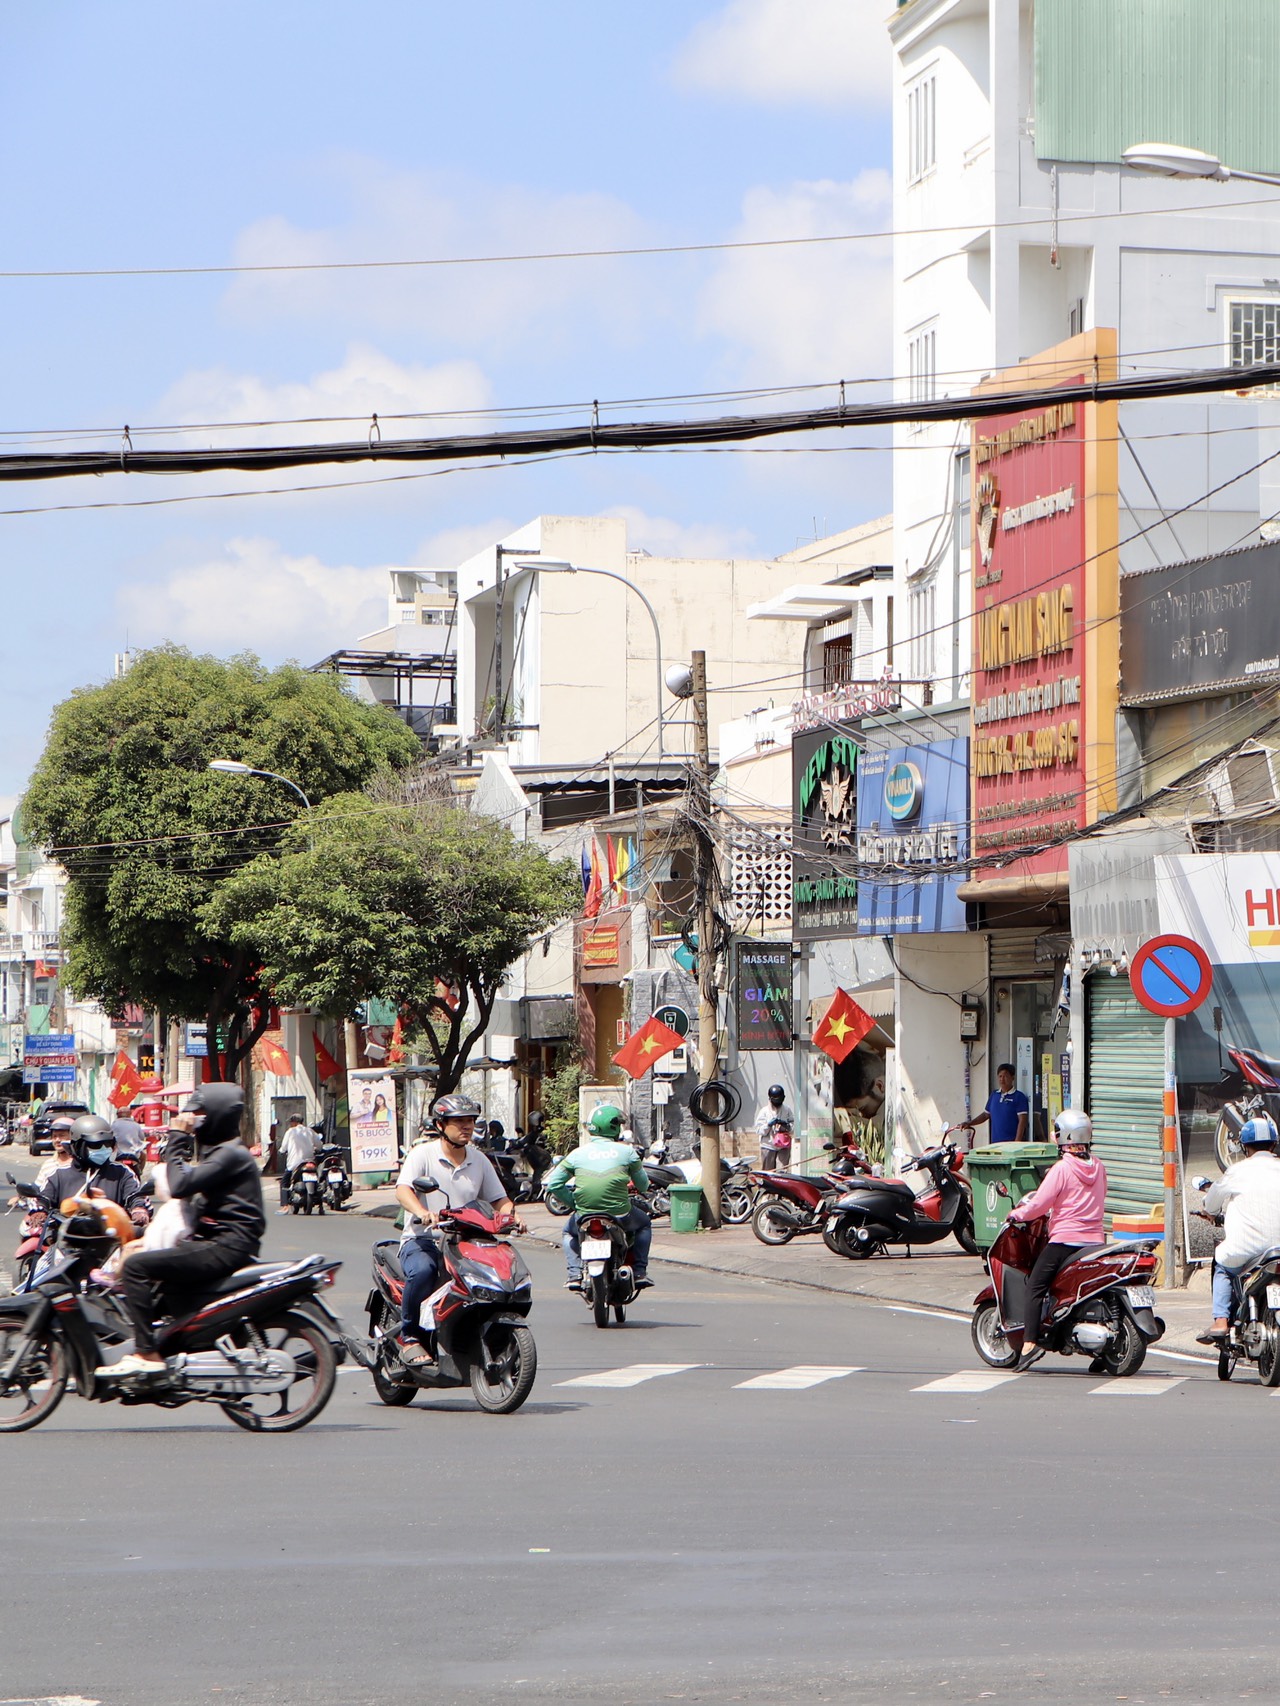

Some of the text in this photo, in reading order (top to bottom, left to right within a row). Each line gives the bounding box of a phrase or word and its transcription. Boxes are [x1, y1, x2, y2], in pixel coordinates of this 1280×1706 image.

[800, 741, 828, 827] NEW
[743, 954, 786, 965] MASSAGE
[745, 983, 788, 1001] GIẢM
[751, 1008, 784, 1023] 20%
[355, 1130, 364, 1138] 15
[361, 1147, 388, 1159] 199K
[588, 1149, 619, 1160] Grab
